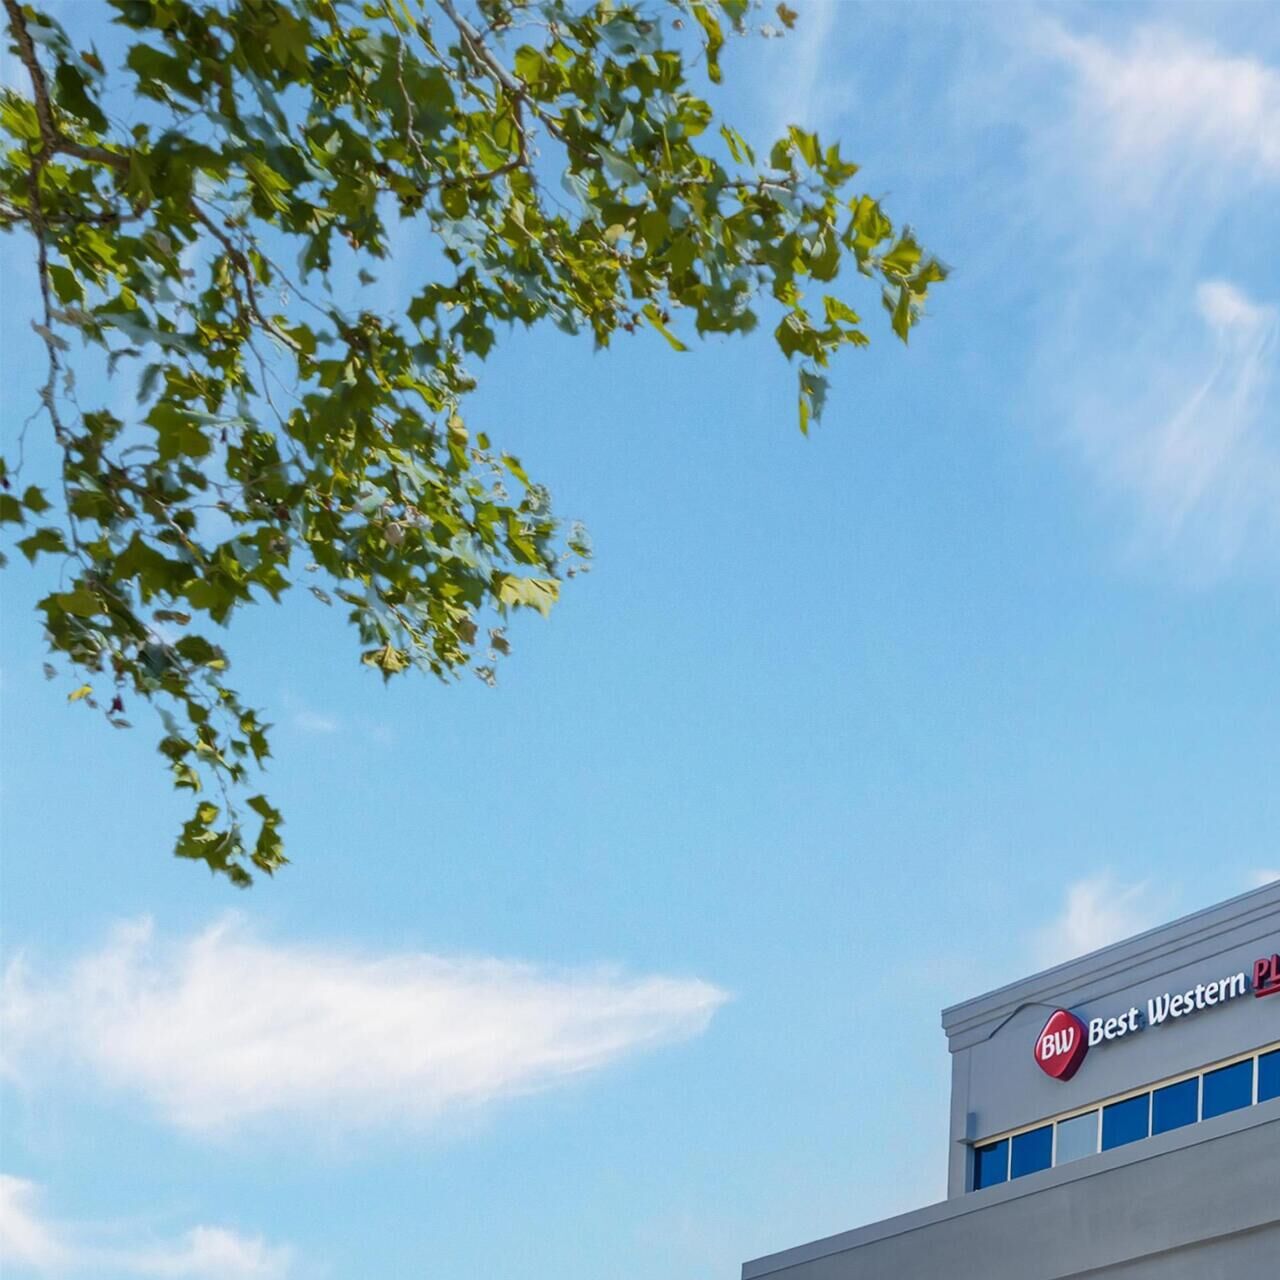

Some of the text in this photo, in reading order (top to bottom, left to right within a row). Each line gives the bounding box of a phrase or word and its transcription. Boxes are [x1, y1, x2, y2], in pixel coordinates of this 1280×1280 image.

[1088, 1007, 1139, 1047] Best
[1147, 971, 1246, 1027] Western
[1041, 1026, 1075, 1060] BW
